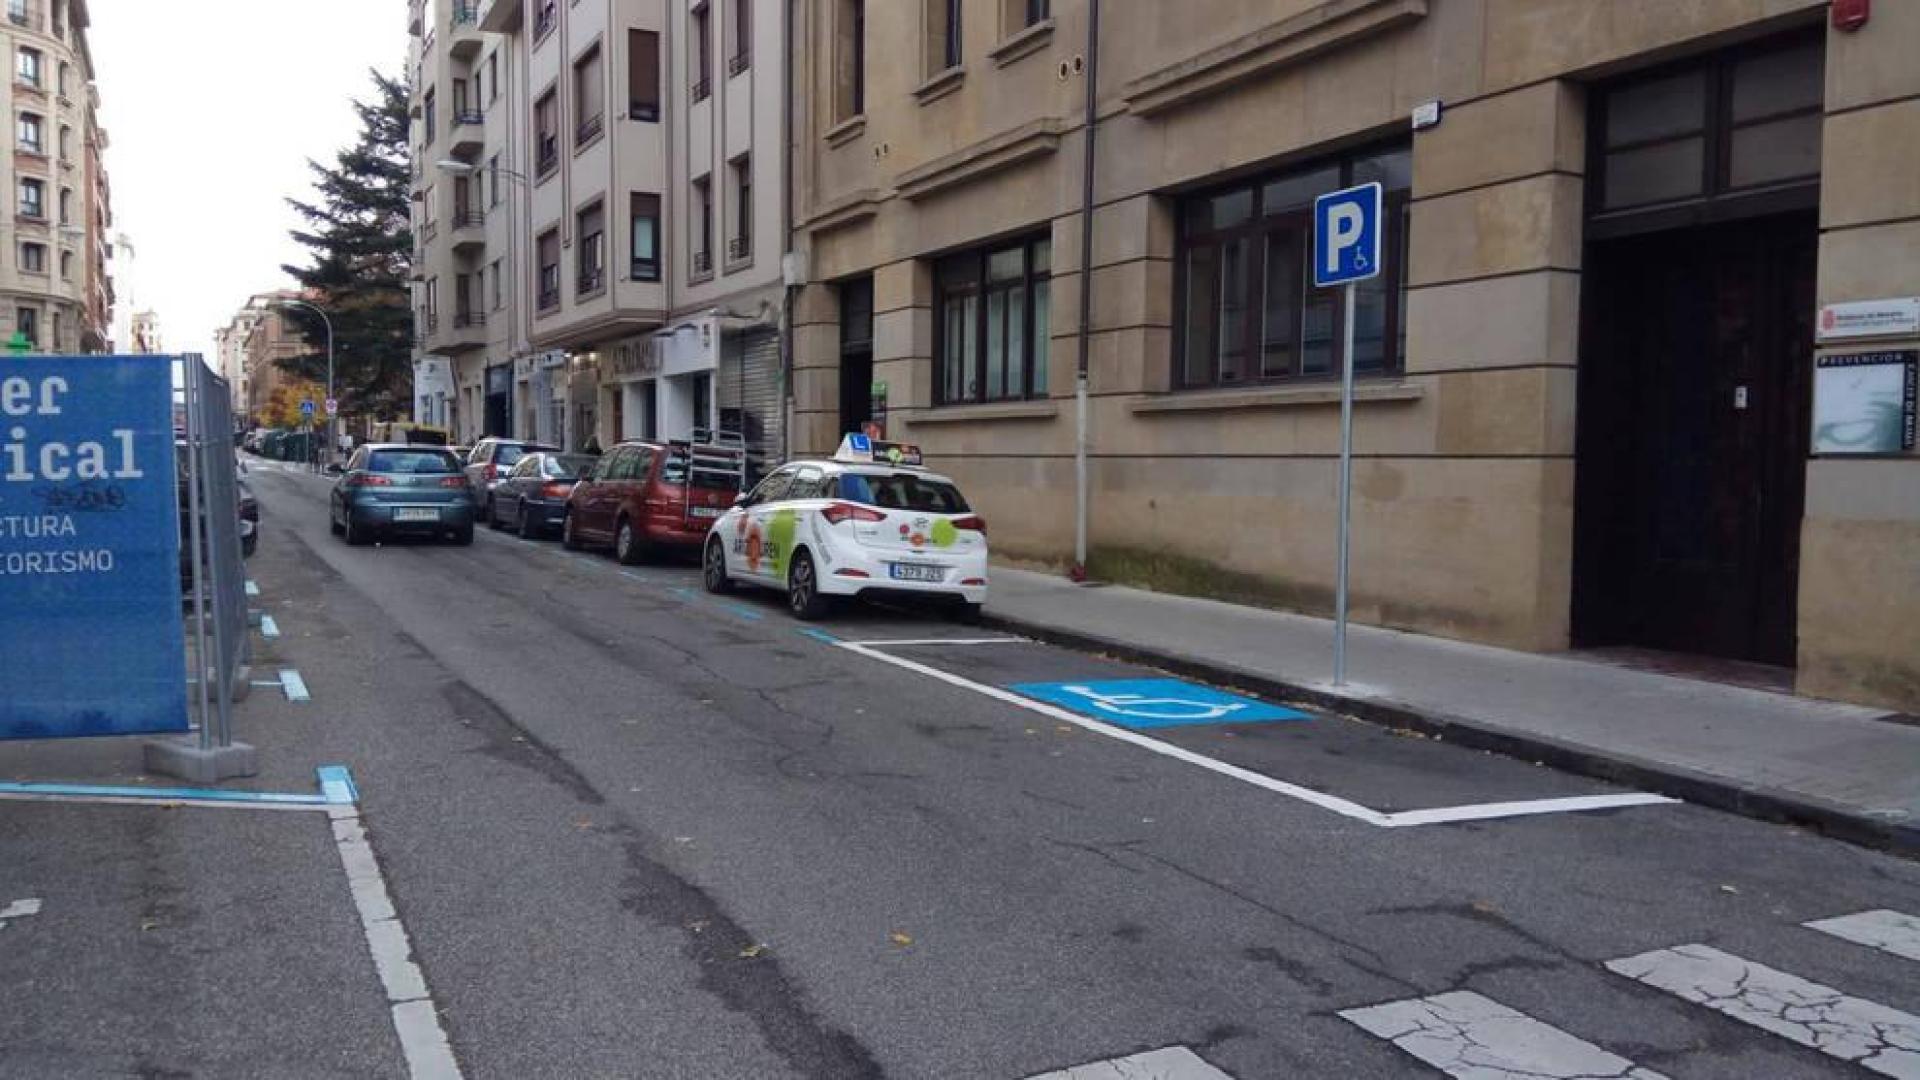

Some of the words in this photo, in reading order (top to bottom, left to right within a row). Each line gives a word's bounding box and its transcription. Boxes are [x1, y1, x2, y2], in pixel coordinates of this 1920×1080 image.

[1327, 201, 1364, 272] P
[4, 426, 144, 481] ical
[853, 435, 866, 449] L
